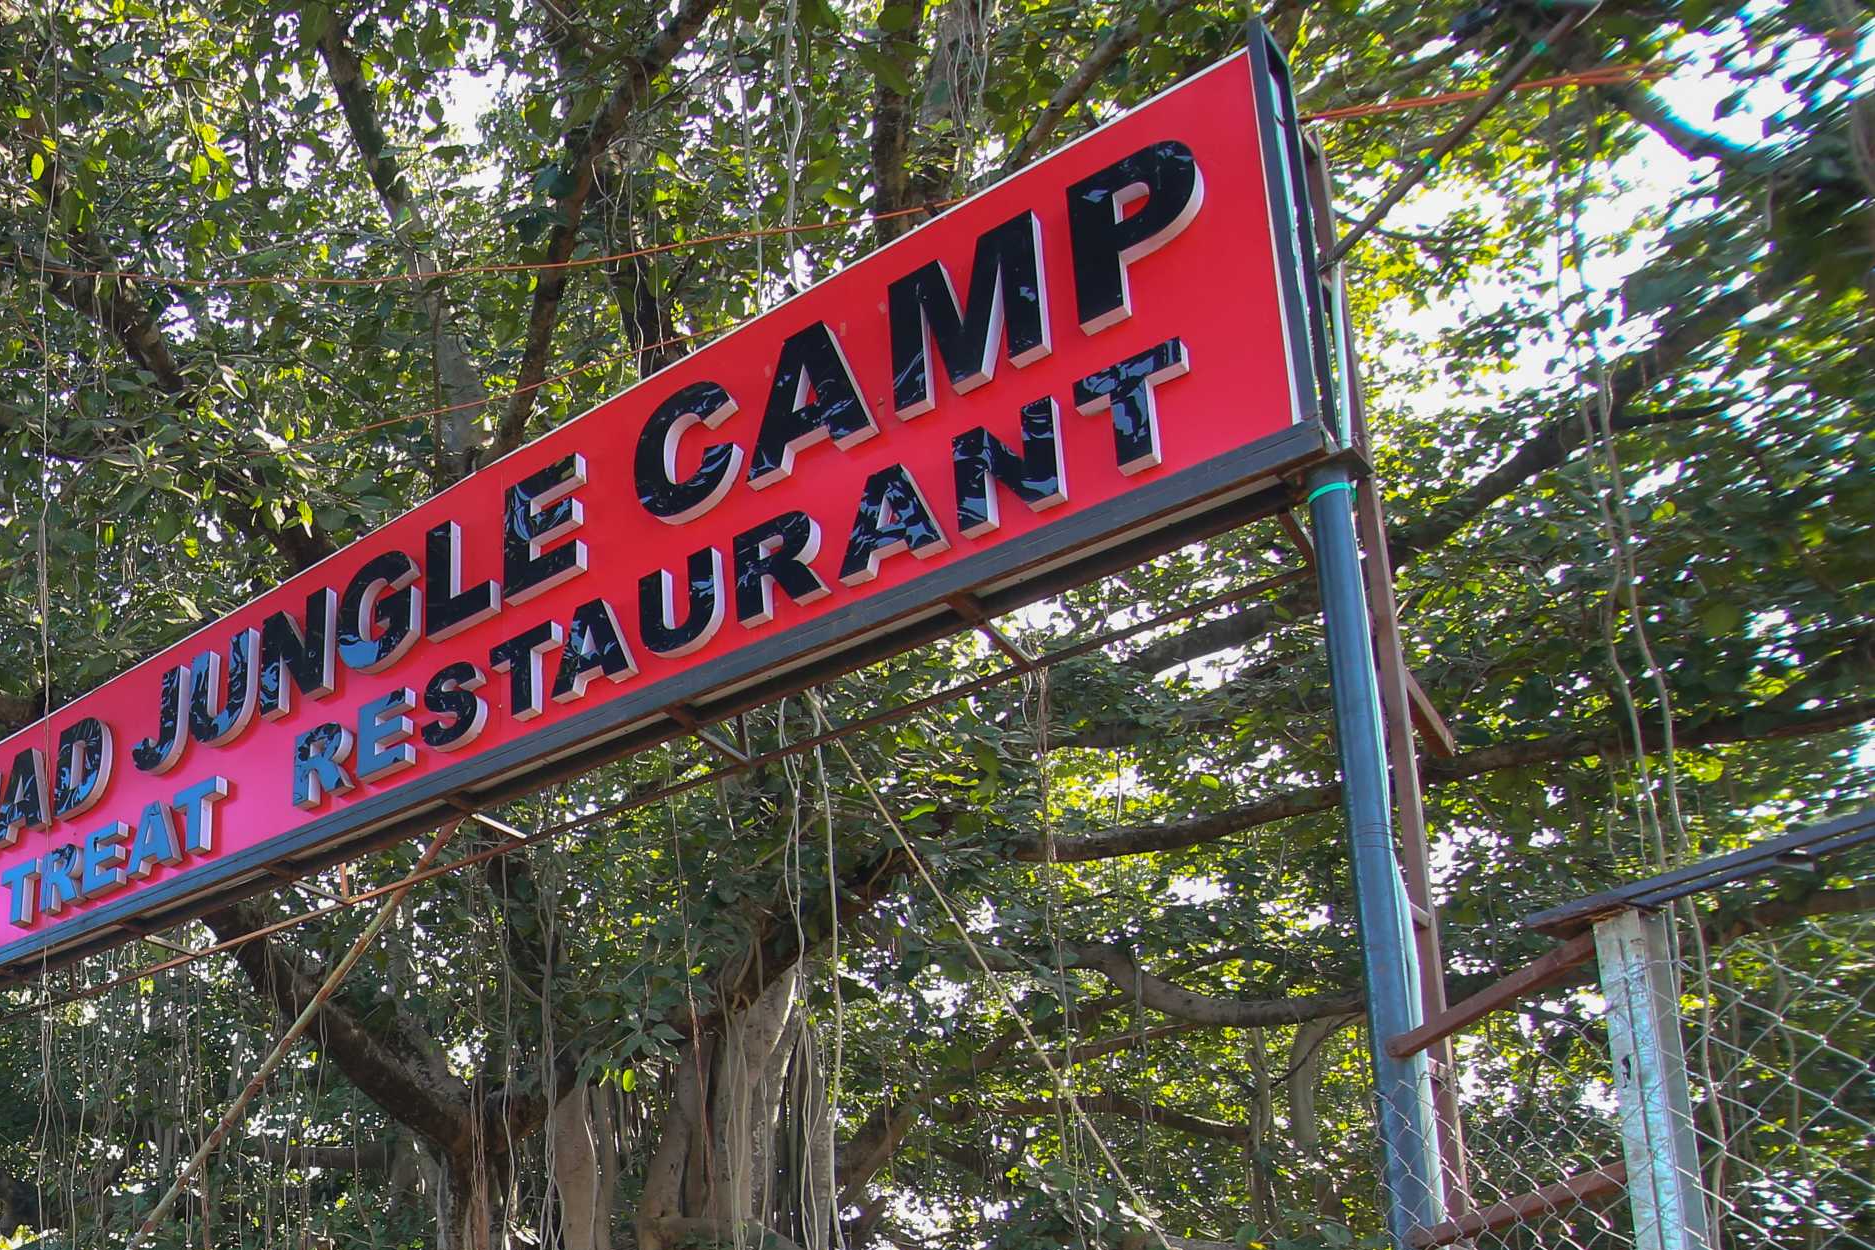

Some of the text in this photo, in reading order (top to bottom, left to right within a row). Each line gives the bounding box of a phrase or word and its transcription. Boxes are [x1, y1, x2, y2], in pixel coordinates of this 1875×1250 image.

[2, 776, 229, 928] TREAT
[293, 336, 1190, 810] RESTAURANT
[132, 452, 588, 776] JUNGLE
[632, 140, 1205, 525] CAMP
